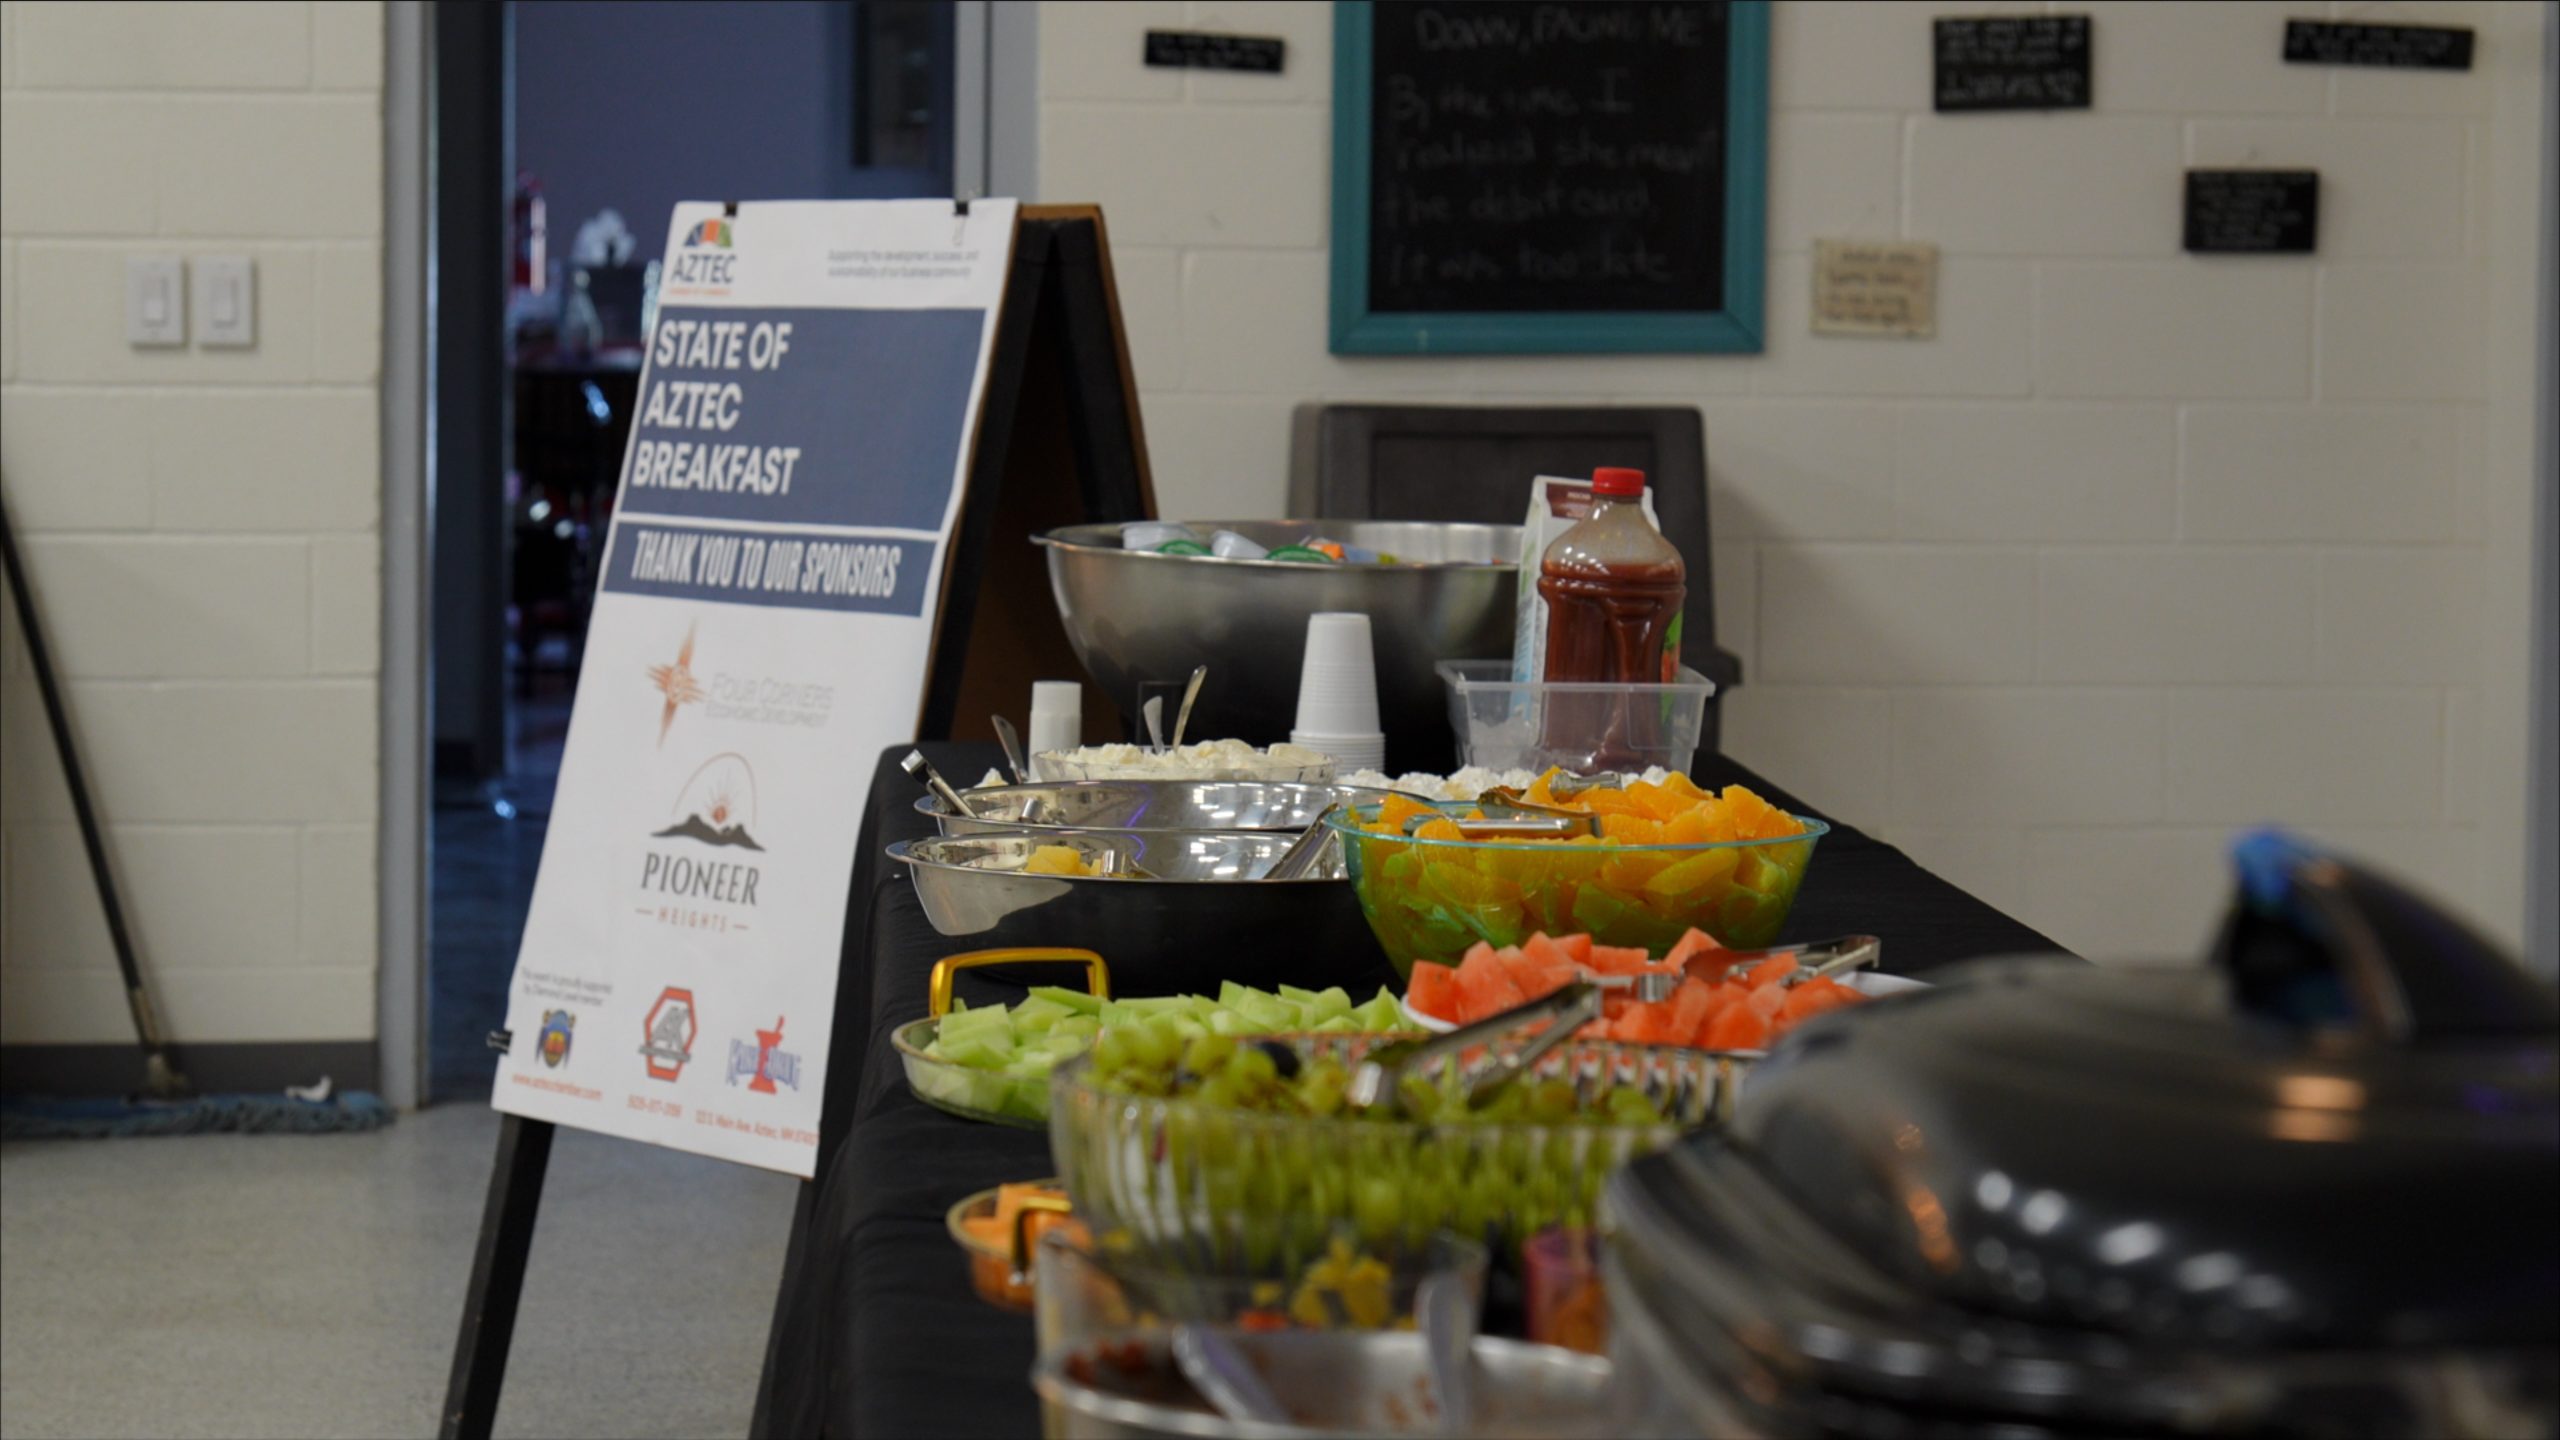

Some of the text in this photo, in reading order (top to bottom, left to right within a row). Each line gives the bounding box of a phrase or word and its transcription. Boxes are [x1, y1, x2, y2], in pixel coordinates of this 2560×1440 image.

[670, 254, 736, 284] AZTEC
[655, 319, 793, 371] STATE OF
[642, 380, 743, 431] AZTEC
[631, 440, 800, 496] BREAKFAST
[631, 530, 902, 598] THANK YOU TO OUR SPONSORS
[640, 851, 760, 907] PIONEER
[658, 905, 728, 934] HEIGHTS
